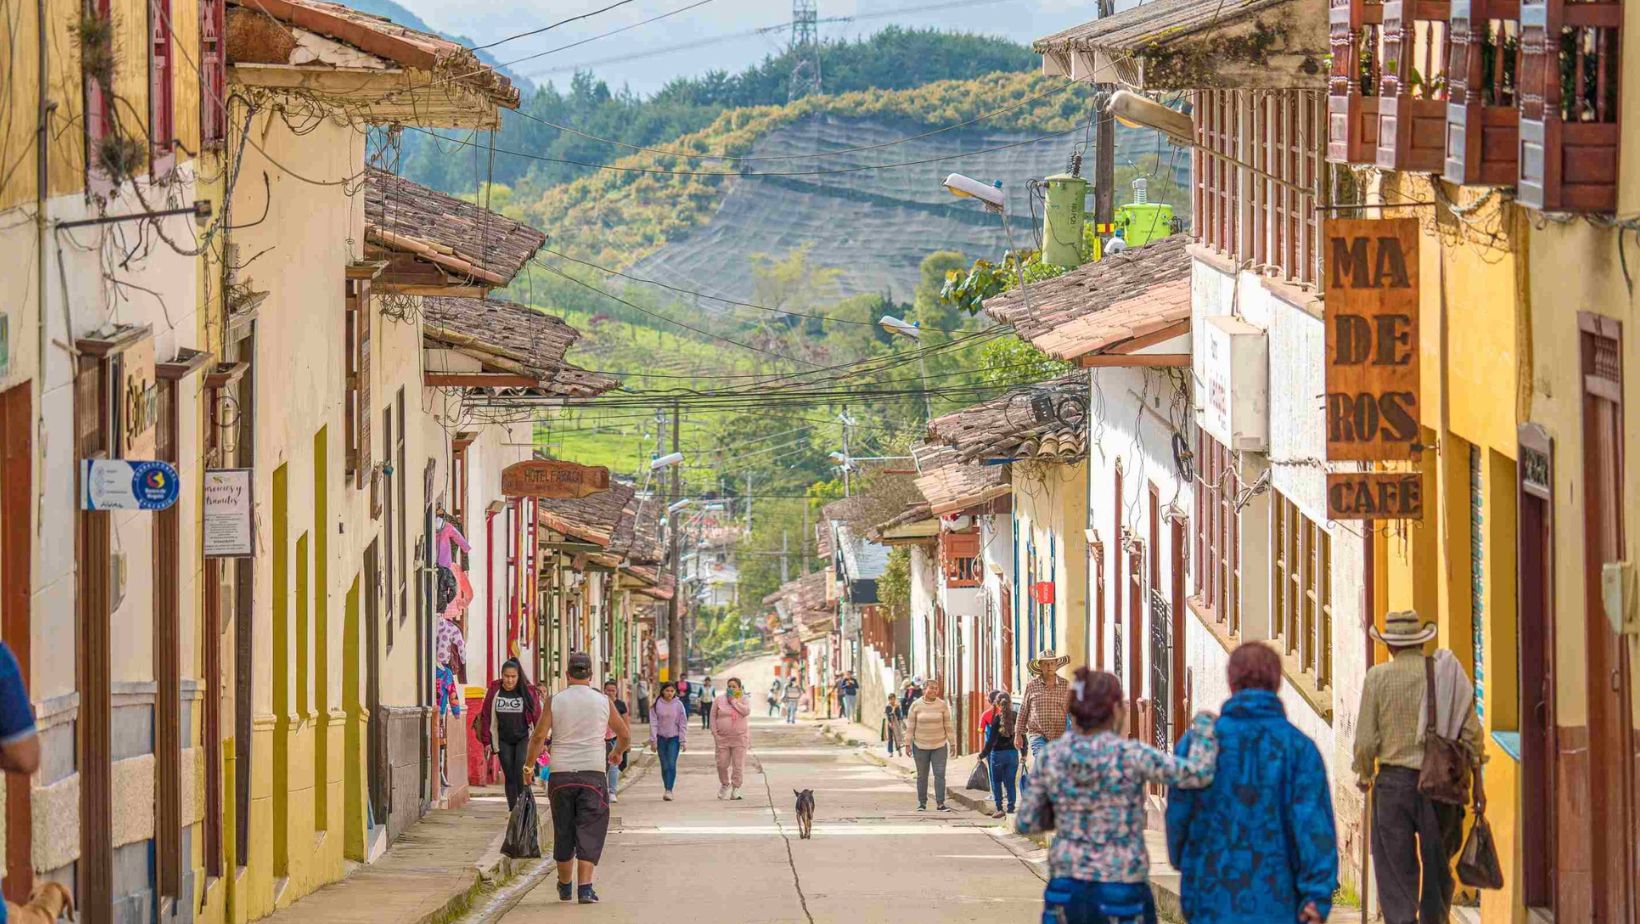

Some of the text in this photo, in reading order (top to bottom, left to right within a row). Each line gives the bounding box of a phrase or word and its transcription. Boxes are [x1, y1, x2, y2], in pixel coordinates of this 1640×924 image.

[1331, 237, 1411, 288] MA
[1333, 314, 1411, 365] DE
[1328, 392, 1418, 442] ROS
[524, 468, 549, 482] HOTEL
[1329, 475, 1419, 514] CAFÉ
[498, 699, 520, 708] D&G
